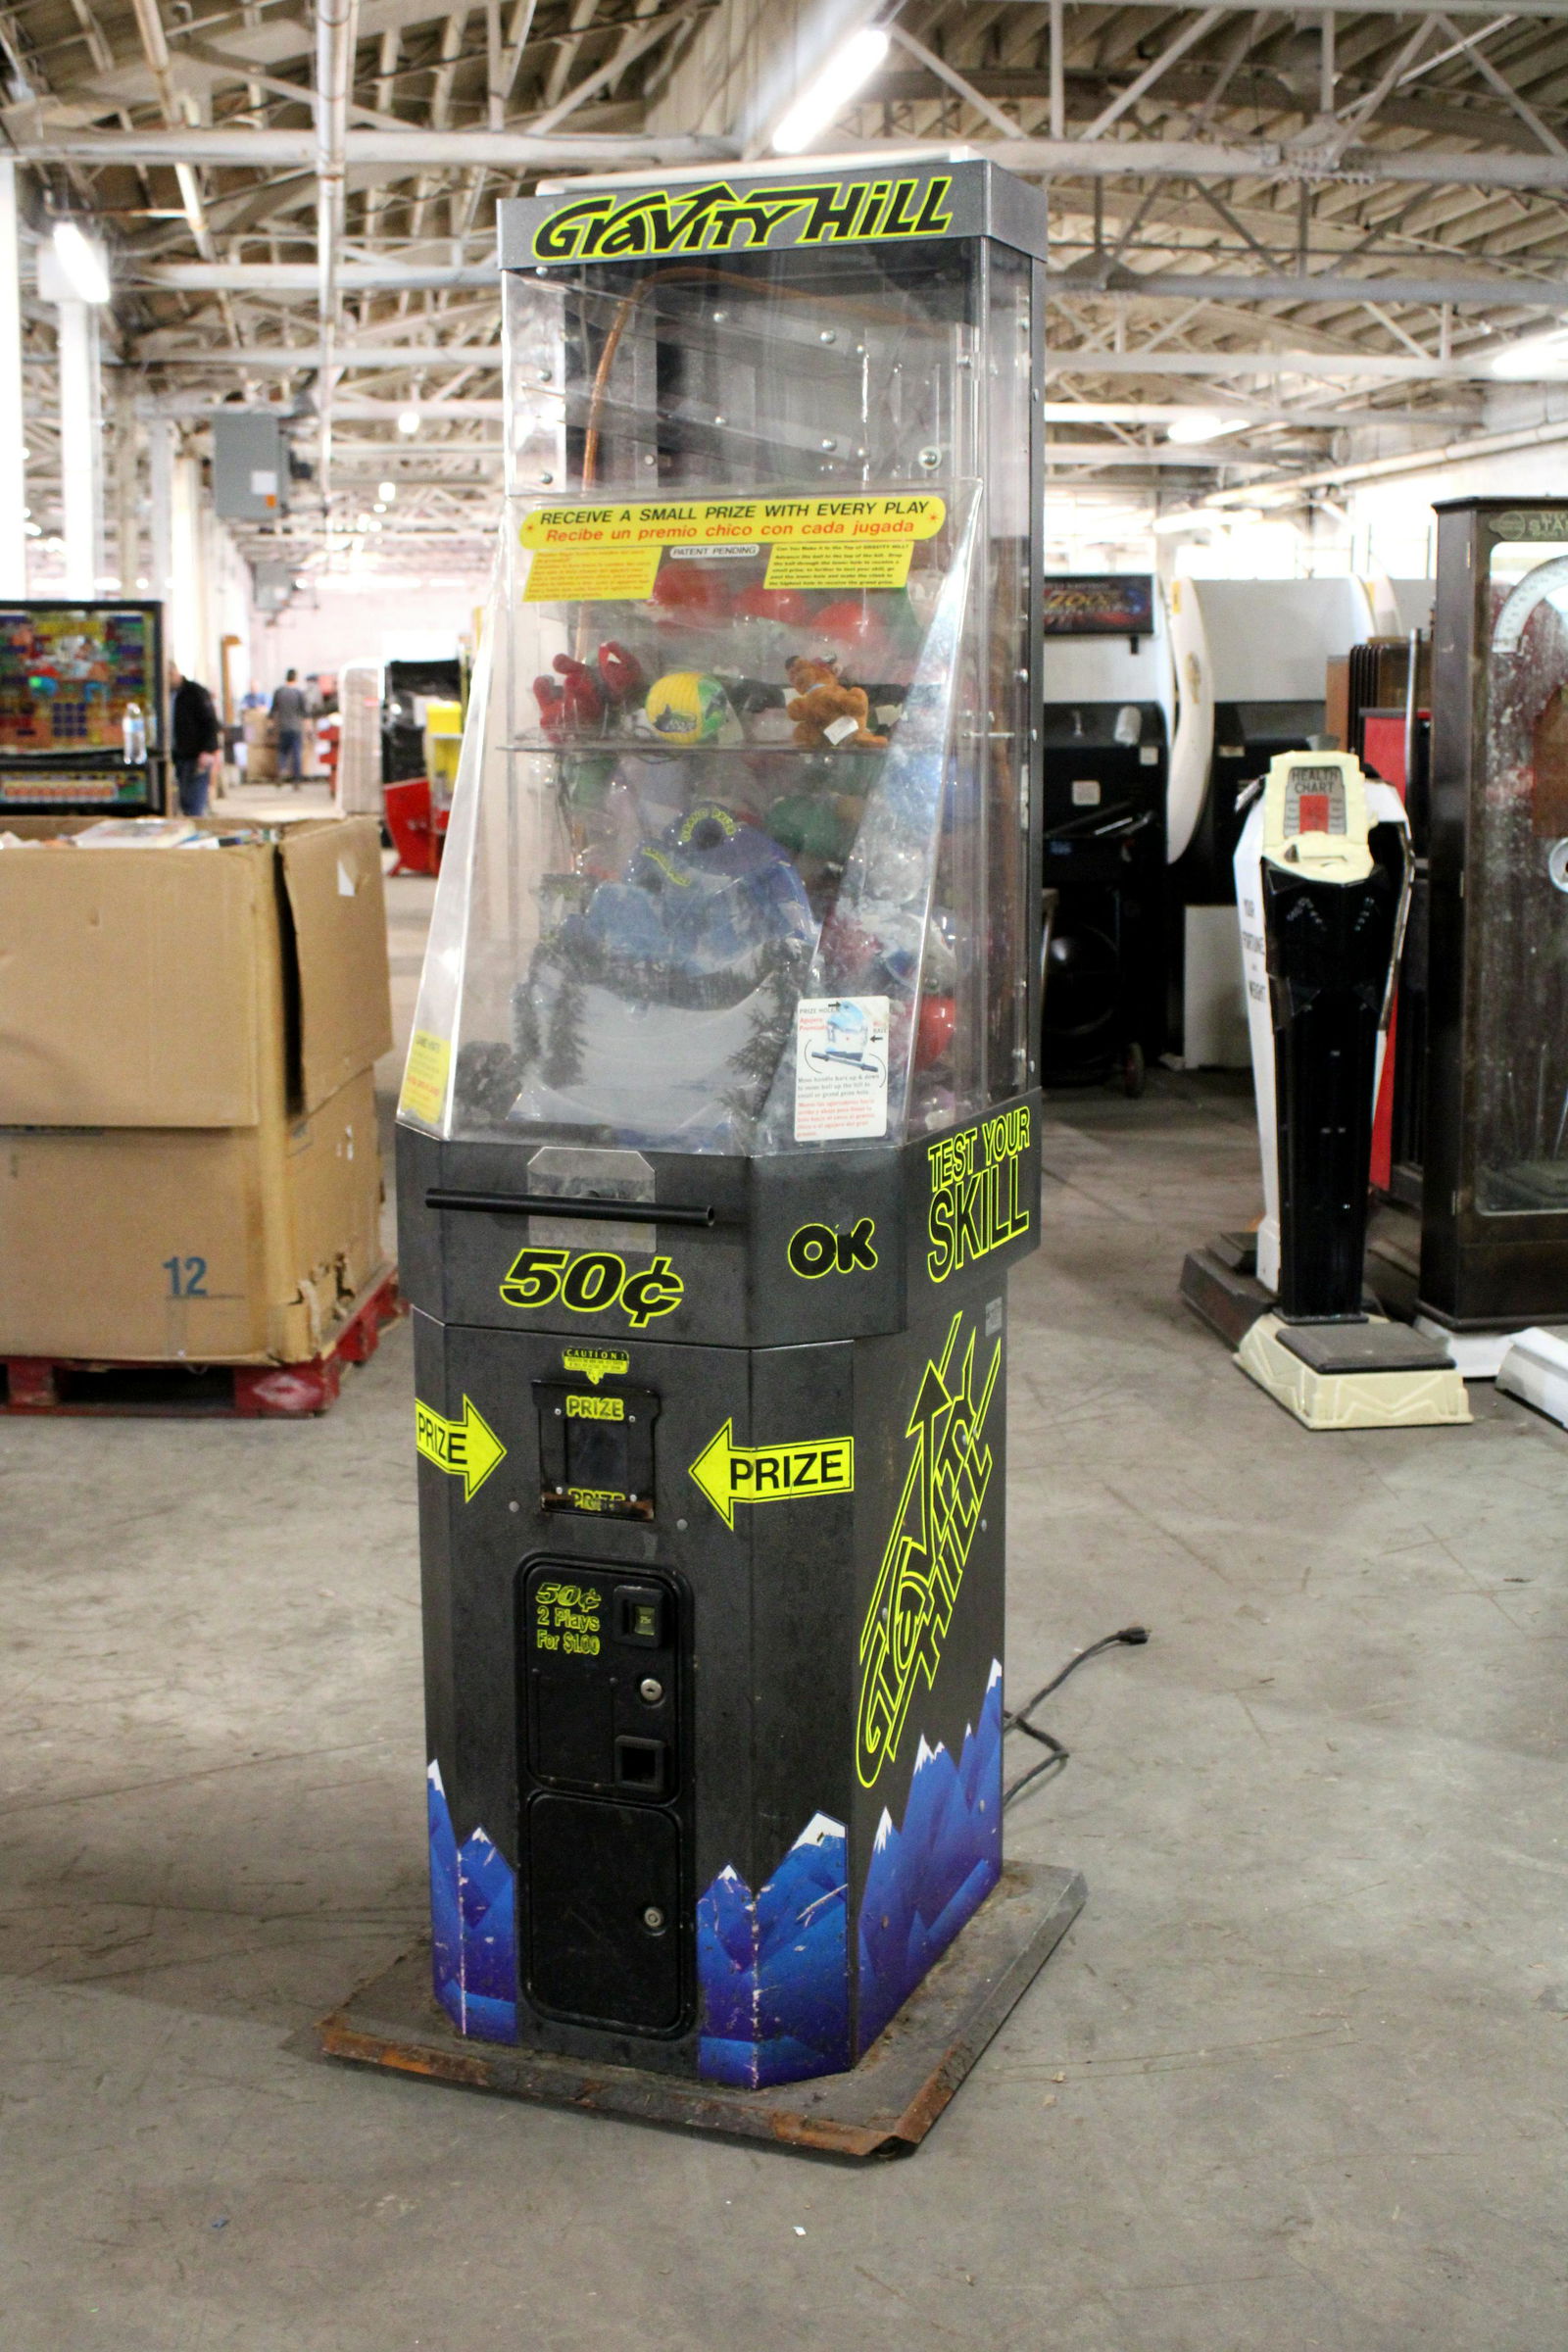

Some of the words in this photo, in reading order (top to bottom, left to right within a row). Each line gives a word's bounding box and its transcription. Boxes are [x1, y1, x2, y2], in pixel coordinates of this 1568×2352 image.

[540, 510, 612, 525] RECEIVE
[619, 510, 631, 522] A
[639, 507, 697, 521] SMALL
[705, 504, 756, 519] PRIZE
[764, 504, 809, 517] WITH
[816, 502, 877, 516] EVERY
[884, 501, 929, 514] PLAY
[546, 527, 604, 542] Recibe
[611, 529, 631, 540] un
[638, 525, 698, 541] premio
[705, 523, 753, 537] chico
[760, 524, 793, 536] con
[801, 521, 844, 535] cada
[852, 520, 914, 535] jugada
[712, 546, 757, 555] PENDING
[1295, 781, 1334, 794] CHART
[928, 1127, 978, 1193] TEST
[982, 1105, 1030, 1166] YOUR
[927, 1154, 1029, 1283] SKILL
[788, 1218, 877, 1278] OK
[163, 1256, 208, 1295] 12
[499, 1248, 684, 1328] 50¢
[566, 1348, 625, 1360] CAUTION!
[565, 1395, 625, 1421] PRIZE
[418, 1411, 467, 1465] PRIZE
[729, 1449, 844, 1491] PRIZE
[535, 1582, 601, 1612] 50¢
[537, 1605, 550, 1626] 2
[554, 1606, 601, 1634] Plays
[537, 1629, 560, 1649] For
[563, 1631, 601, 1655] $1.00
